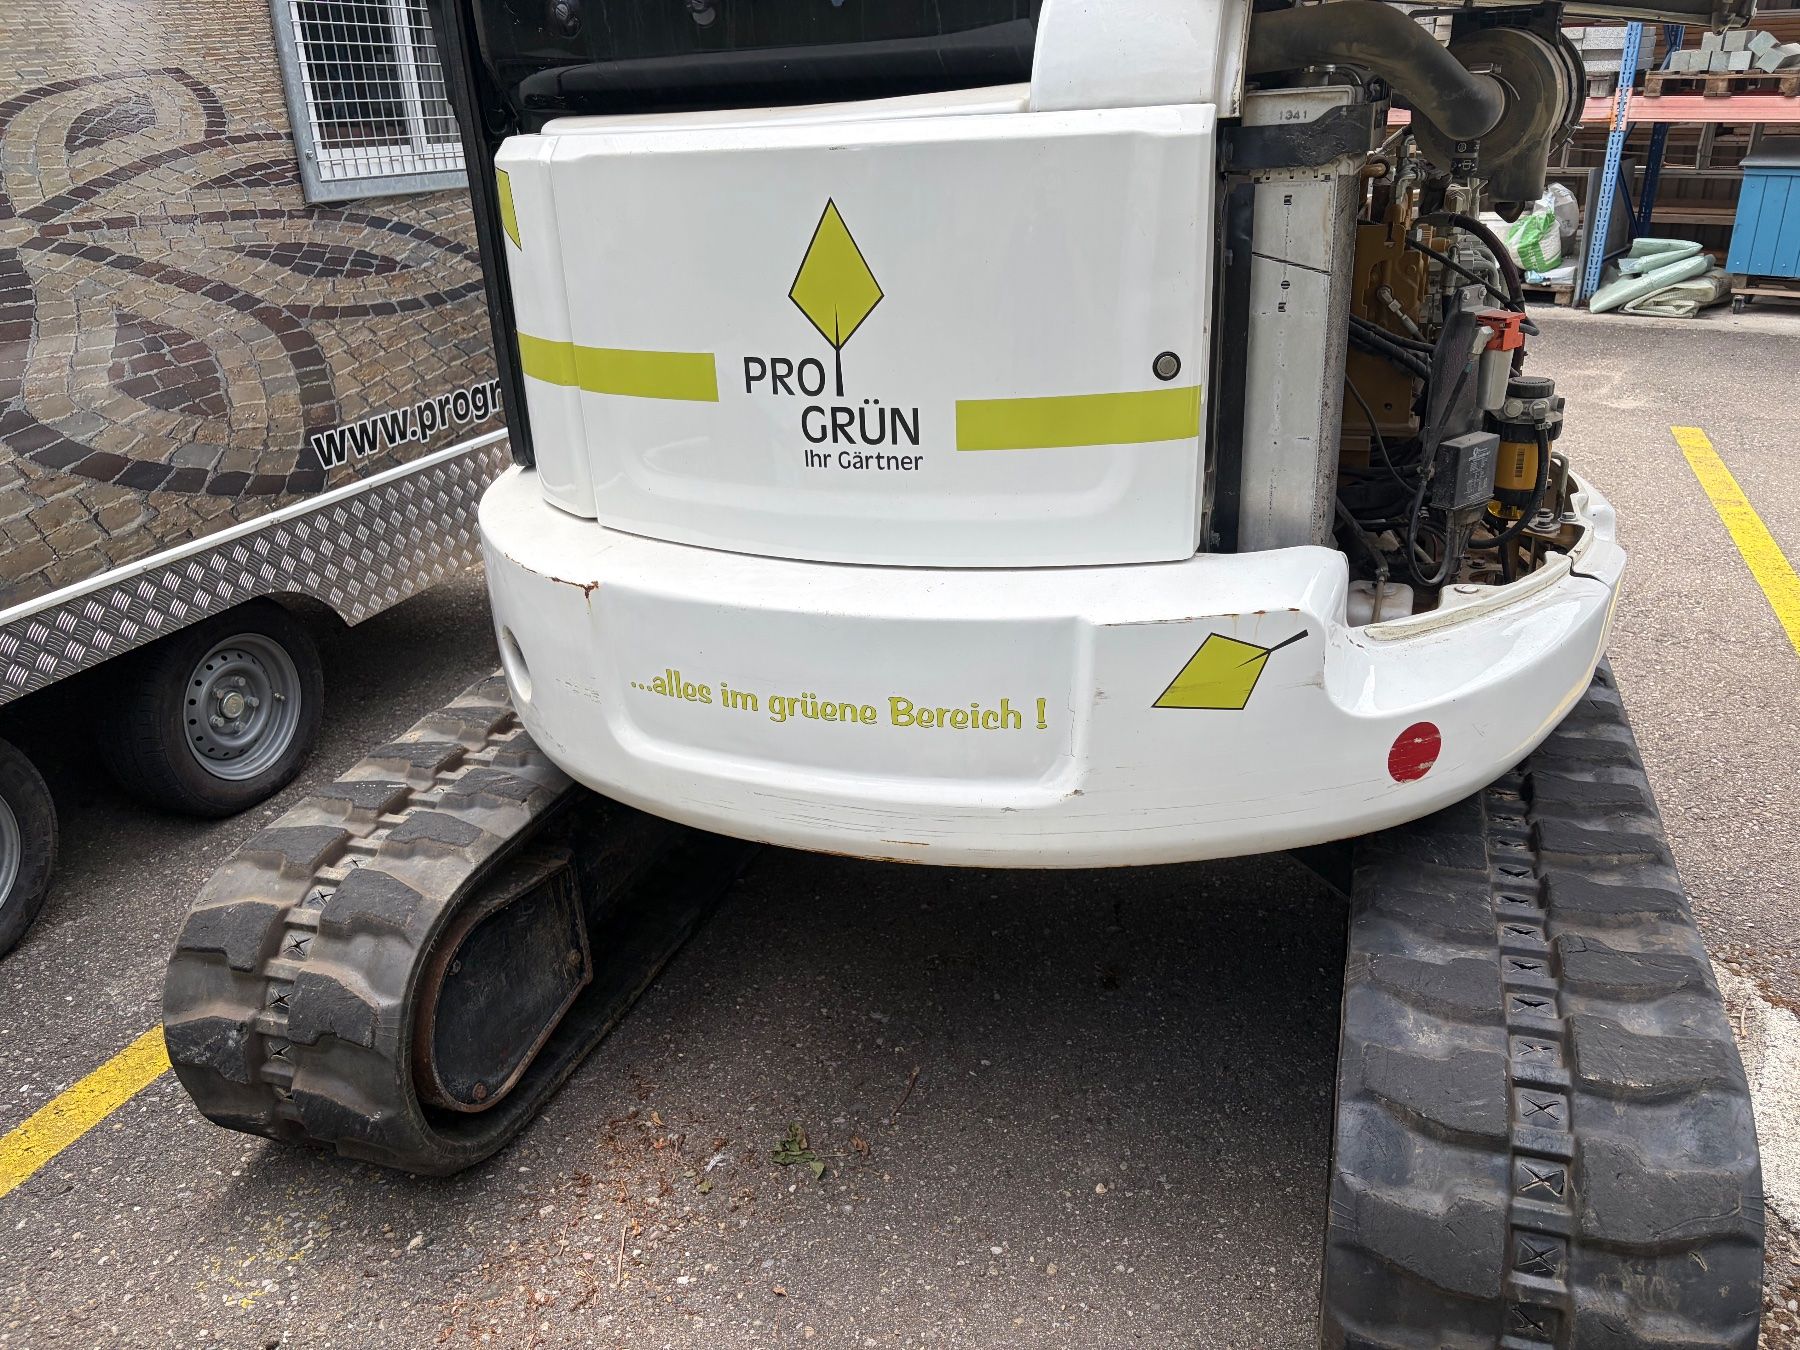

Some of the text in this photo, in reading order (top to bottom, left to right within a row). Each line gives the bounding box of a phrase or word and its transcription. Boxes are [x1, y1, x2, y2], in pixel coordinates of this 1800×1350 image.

[743, 356, 826, 397] PRO
[801, 398, 920, 446] GRÜN
[804, 449, 924, 471] Ihr Gärtner
[720, 682, 759, 712] im
[768, 692, 878, 725] grüene
[887, 696, 1022, 730] Bereich
